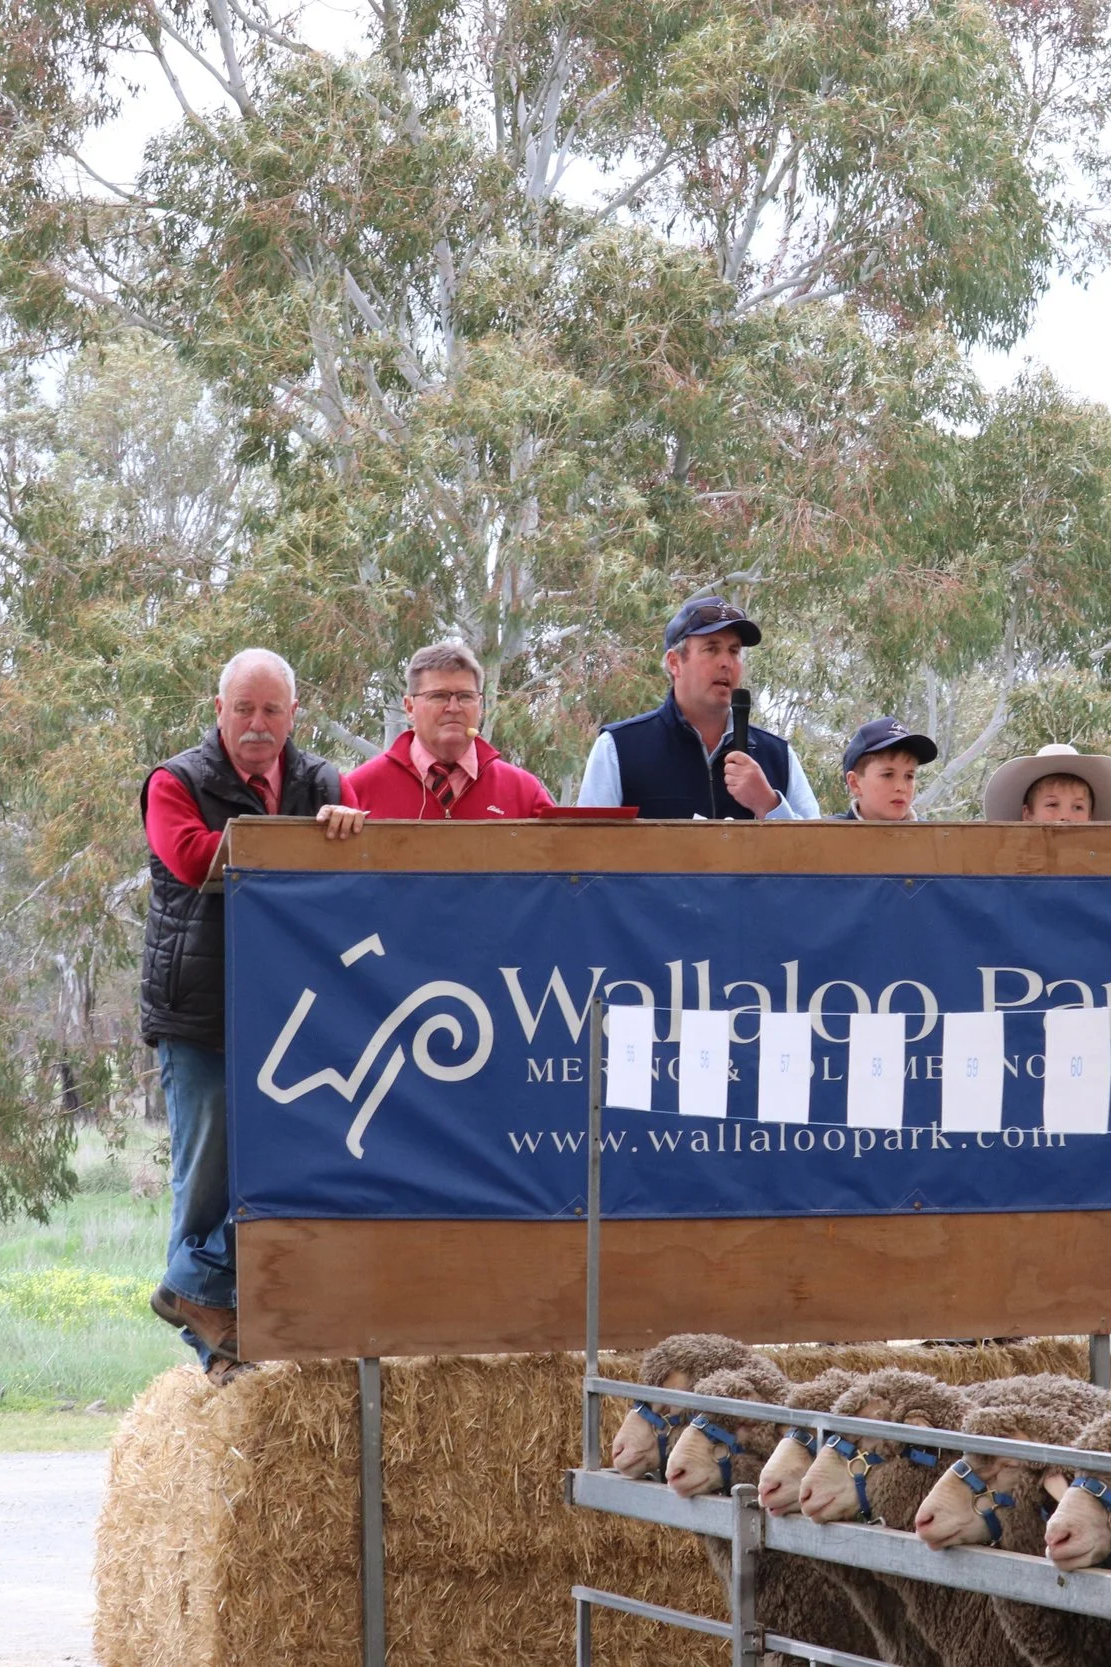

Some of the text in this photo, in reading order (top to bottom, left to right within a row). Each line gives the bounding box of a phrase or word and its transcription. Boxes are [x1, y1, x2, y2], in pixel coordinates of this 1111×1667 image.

[779, 1053, 791, 1073] 57
[871, 1057, 883, 1077] 58
[966, 1057, 979, 1077] 59
[1070, 1056, 1083, 1077] 60
[508, 1121, 1067, 1158] www.wallaloopark.com
